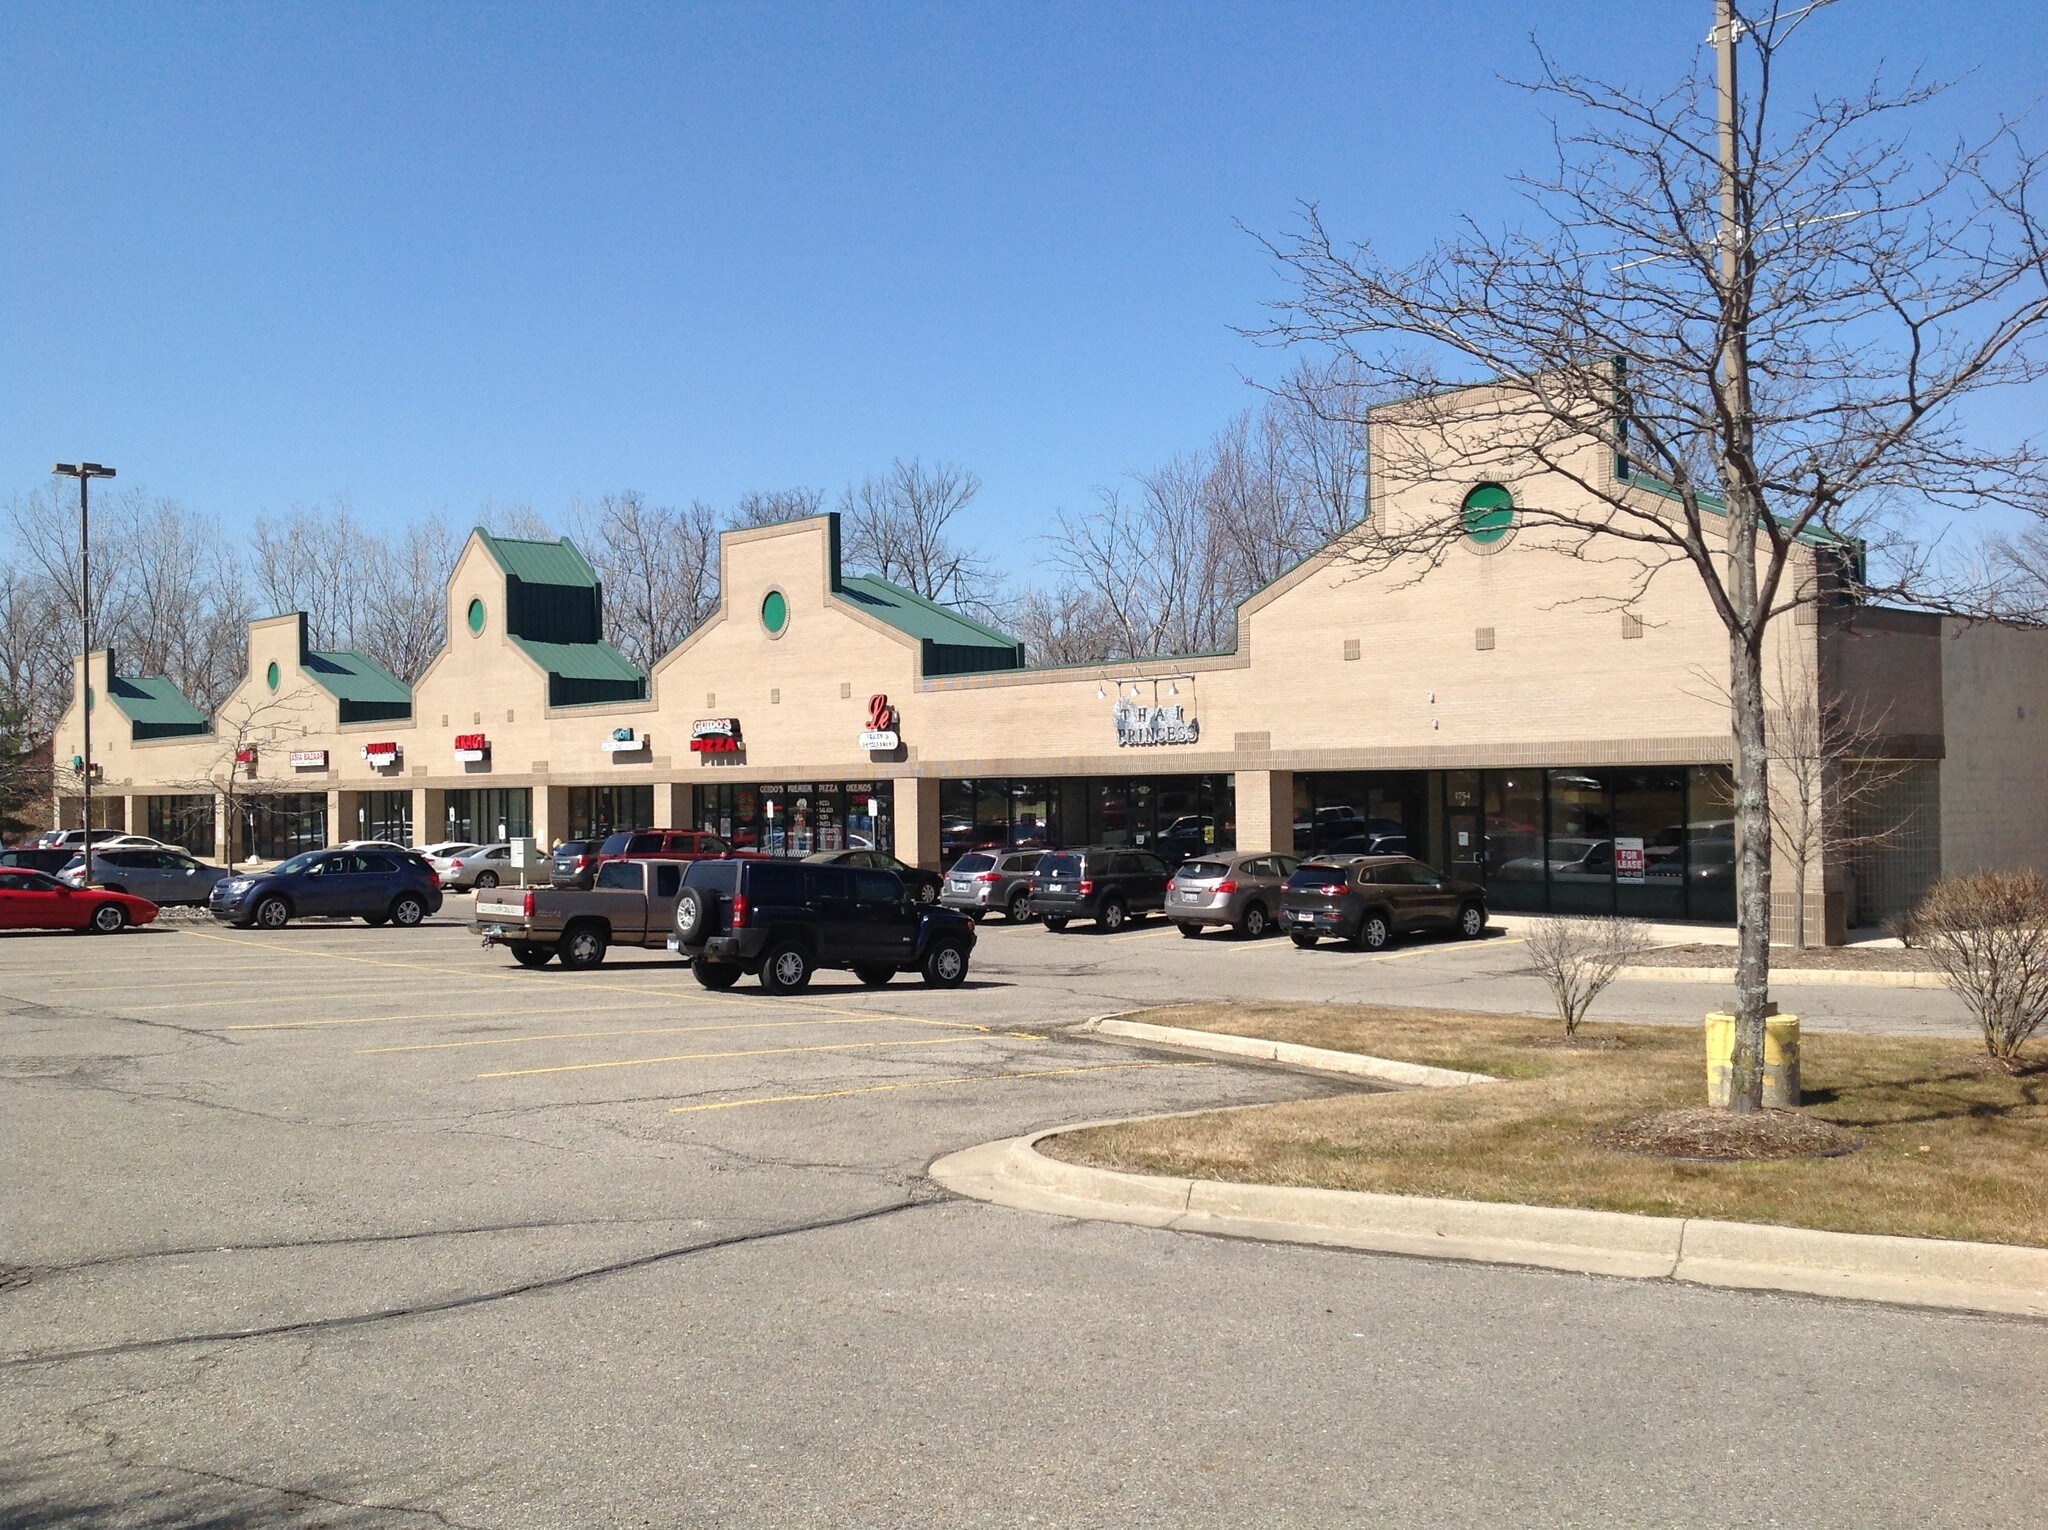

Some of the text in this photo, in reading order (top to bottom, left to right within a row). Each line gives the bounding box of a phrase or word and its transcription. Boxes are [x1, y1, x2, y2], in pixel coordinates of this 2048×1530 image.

[866, 694, 890, 729] Le
[1121, 705, 1183, 721] THAI
[693, 719, 732, 731] GUIDO'S
[1118, 725, 1197, 743] PRINCESS
[690, 738, 738, 752] PIZZA
[291, 752, 325, 761] ASIA BAZAAR
[759, 783, 872, 793] GUIDO'S PREMIUM PIZZA OKEMOS
[1621, 850, 1638, 860] FOR
[1617, 860, 1643, 869] LEASE
